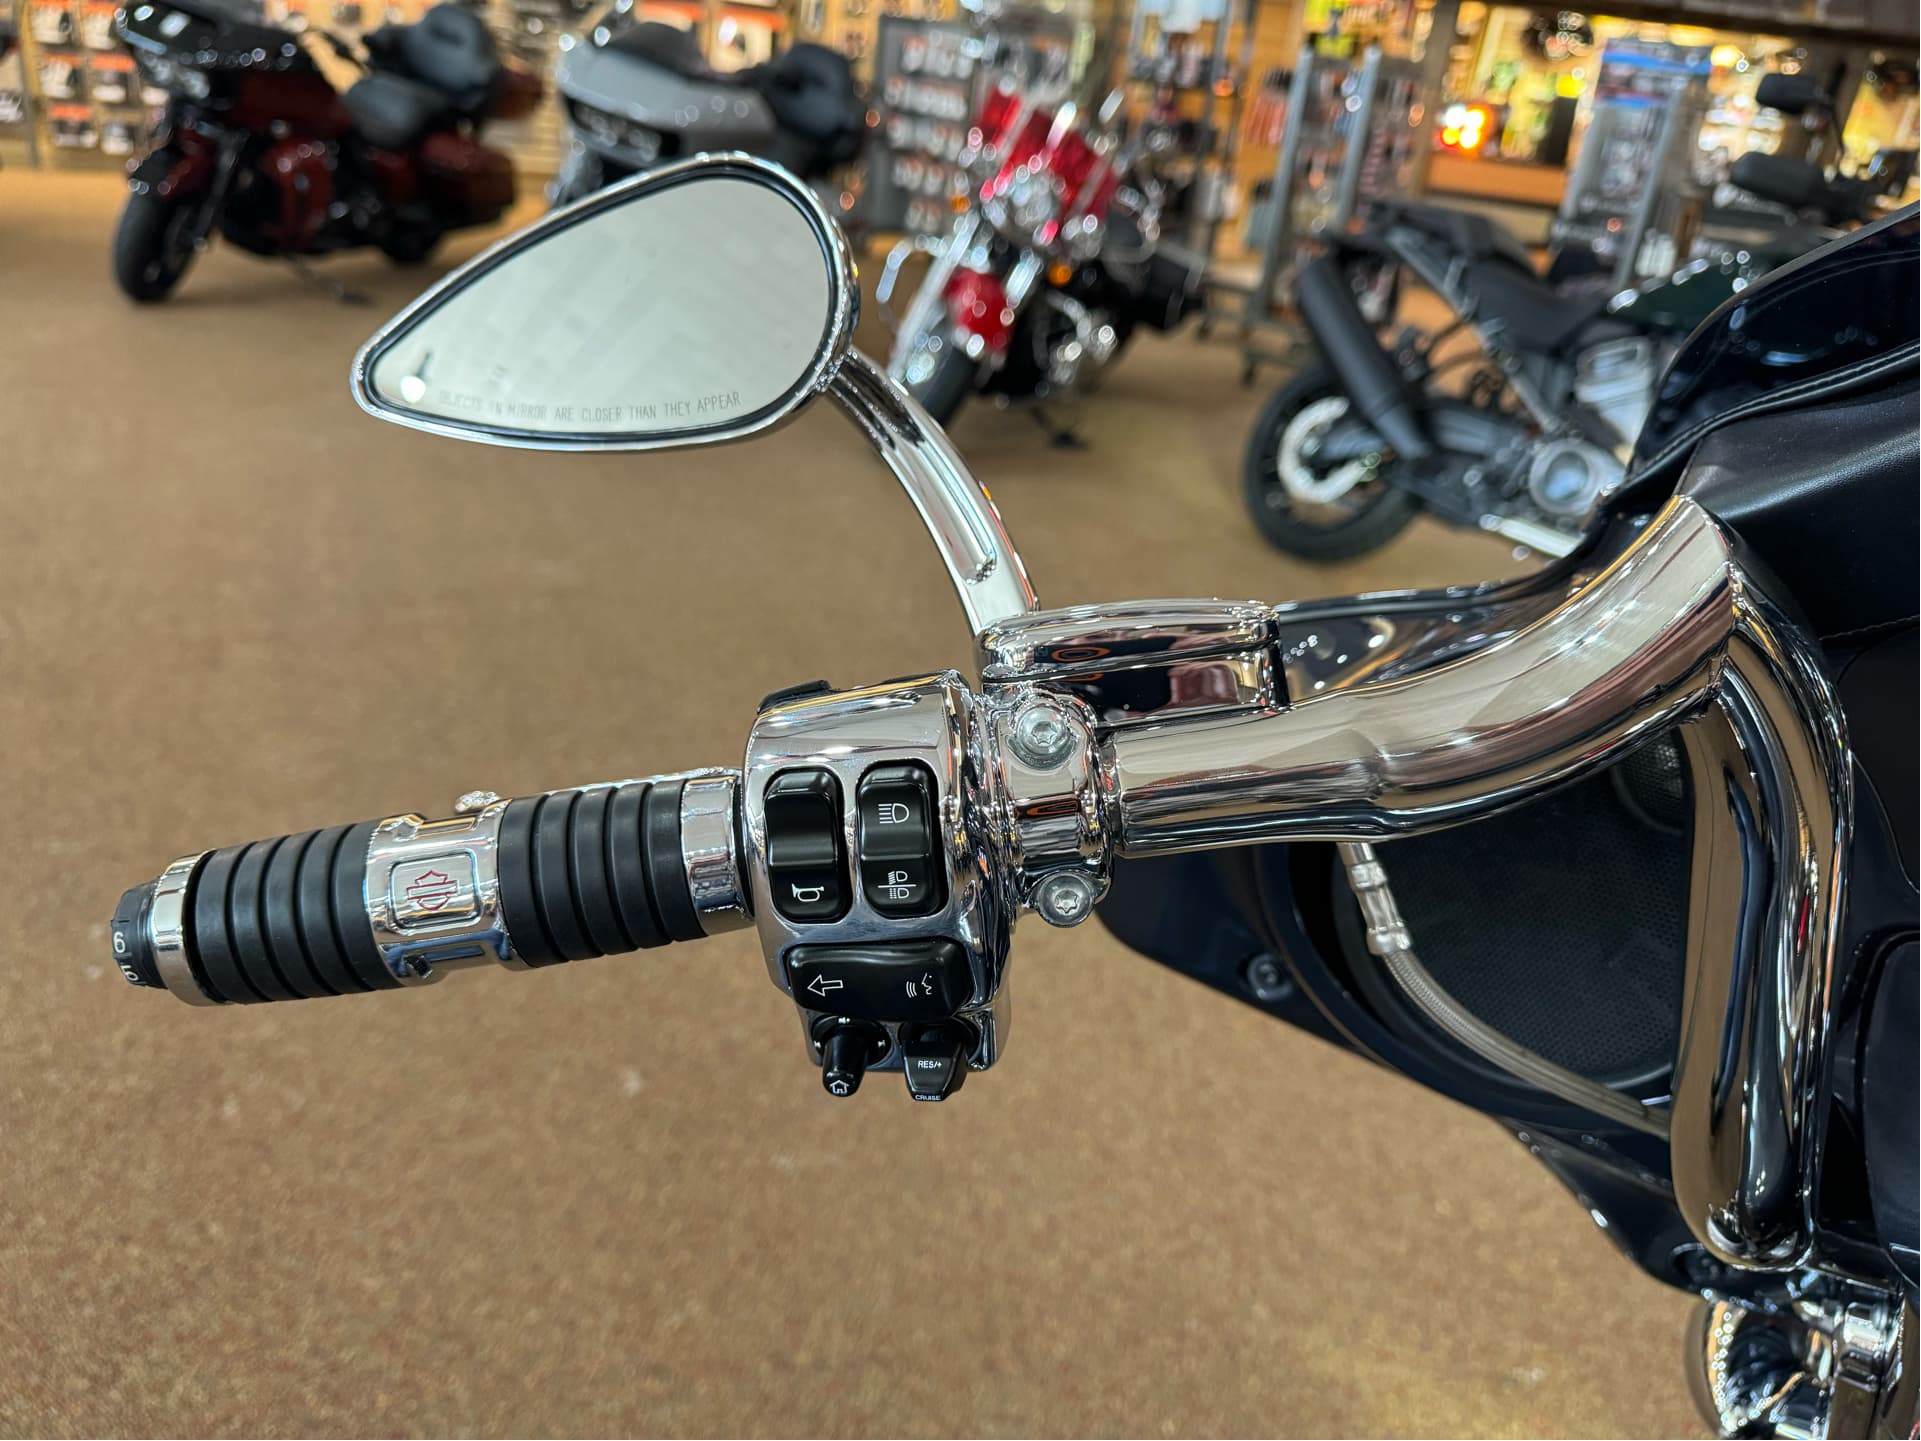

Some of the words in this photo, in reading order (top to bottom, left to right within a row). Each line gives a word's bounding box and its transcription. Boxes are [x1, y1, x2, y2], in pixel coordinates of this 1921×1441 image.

[508, 403, 546, 418] MIRROR
[554, 407, 575, 422] ARE
[582, 407, 622, 423] CLOSER
[630, 404, 657, 420] THAN
[664, 400, 691, 417] THEY
[697, 391, 742, 413] APPEAR
[113, 931, 126, 953] 6
[917, 1060, 942, 1069] RES/+
